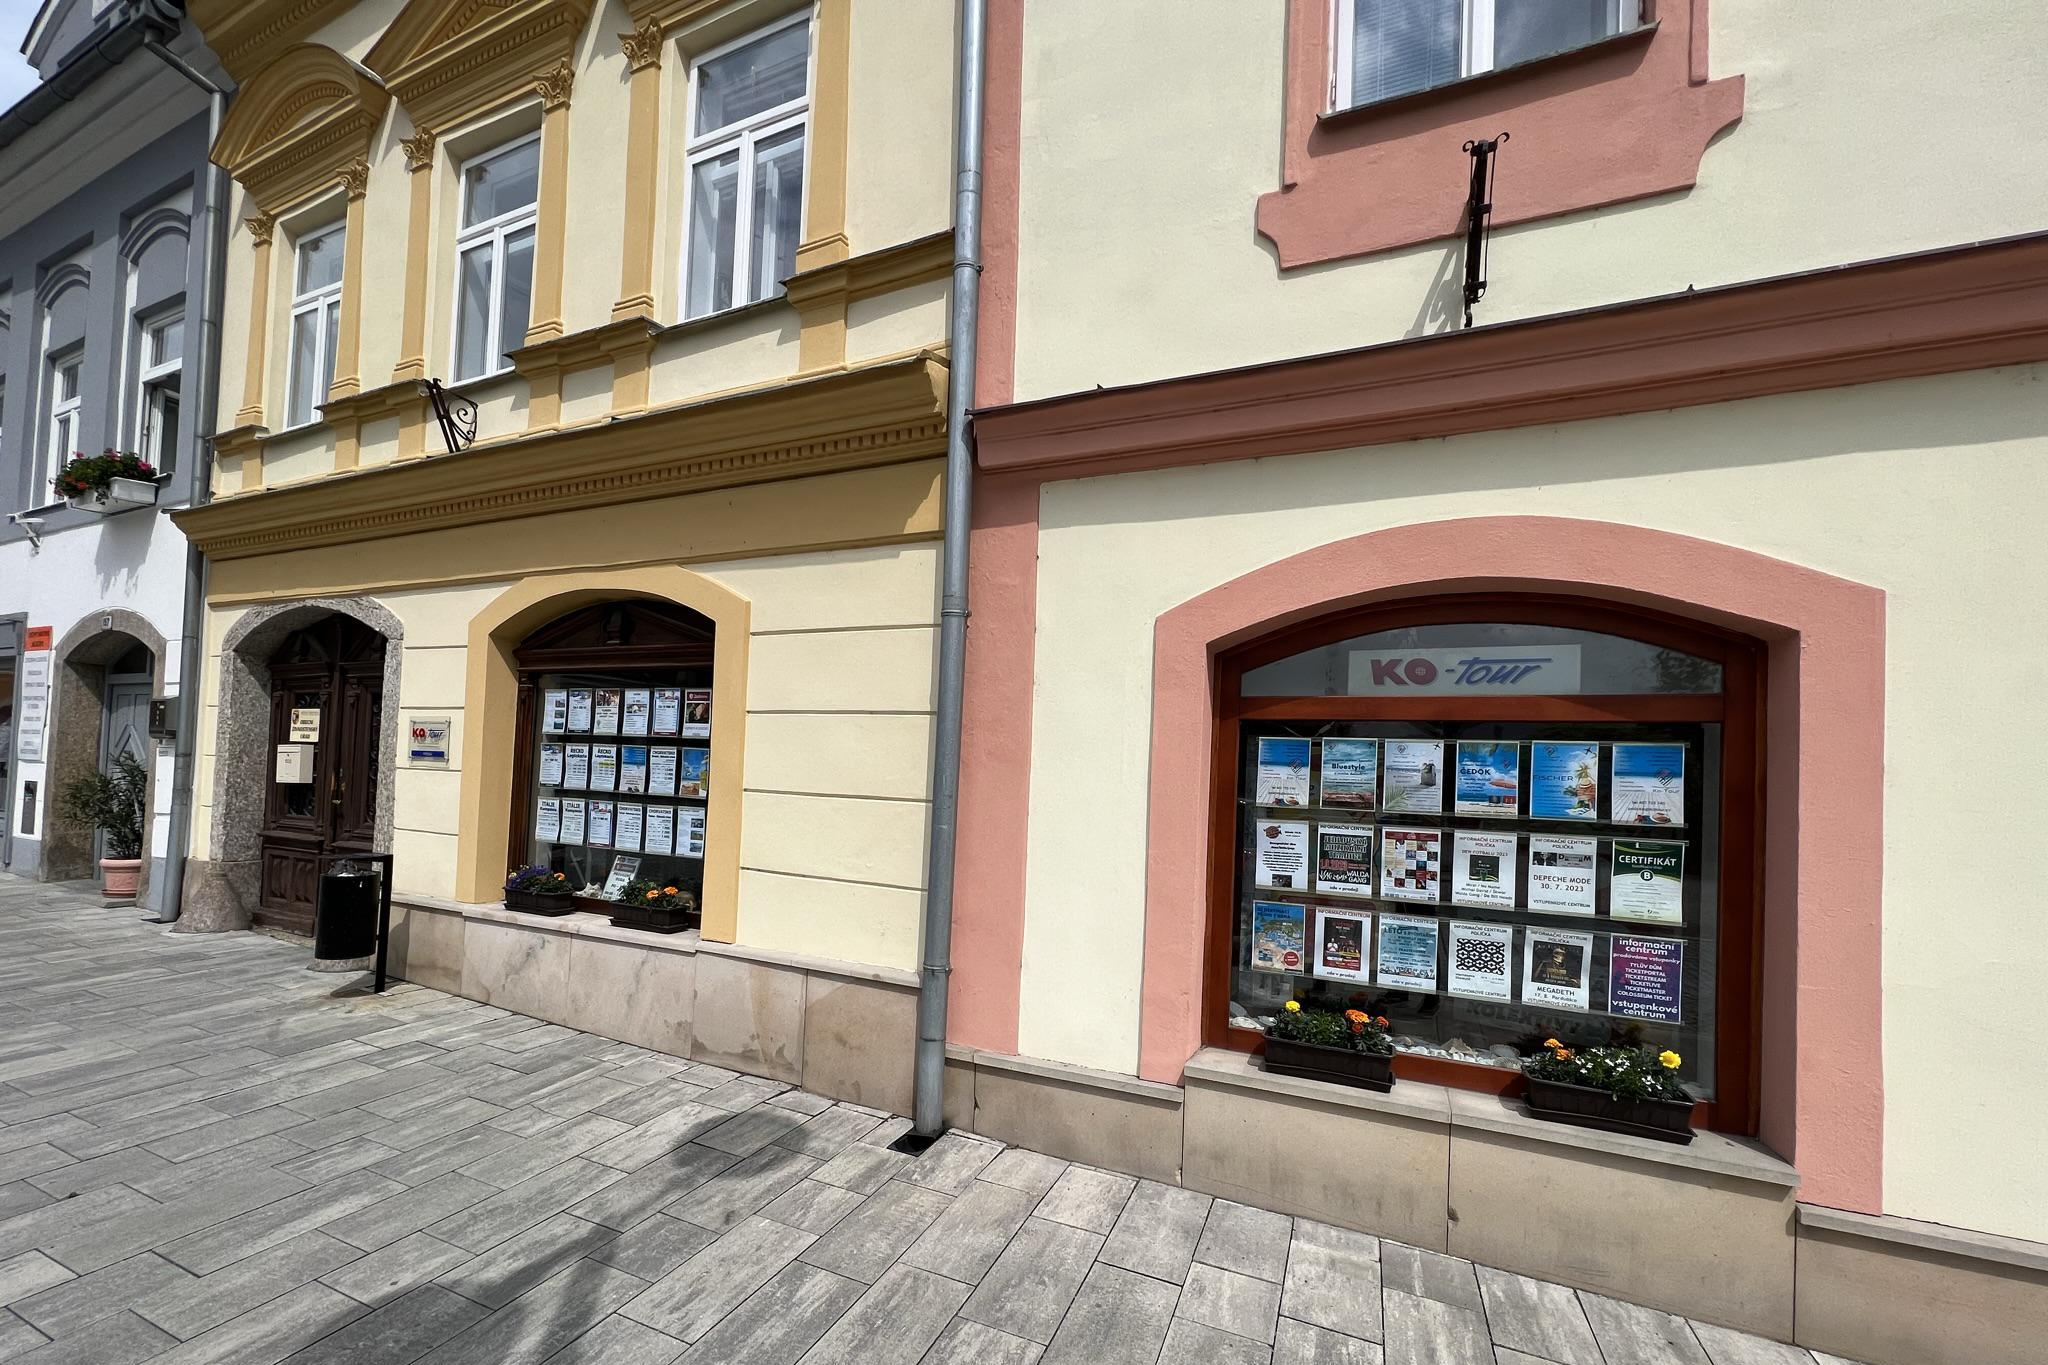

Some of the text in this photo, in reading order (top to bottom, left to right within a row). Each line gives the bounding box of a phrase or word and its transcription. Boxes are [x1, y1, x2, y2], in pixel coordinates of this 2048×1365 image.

[1331, 763, 1366, 771] Bluestyle
[1460, 766, 1491, 775] ČEDOK
[1618, 855, 1677, 866] CERTIFIKÁT
[1533, 874, 1591, 885] DEPECHE MODE
[1643, 871, 1651, 880] B
[1565, 884, 1584, 892] 2023
[1619, 938, 1675, 950] informační
[1625, 946, 1668, 955] centrum
[1625, 968, 1666, 977] TICKETPORTAL
[1625, 974, 1667, 982] TICKETSTREAM
[1630, 980, 1661, 988] TICKETLIVE
[1536, 986, 1575, 996] MEGADETH
[1617, 990, 1653, 998] COLOSSEUM
[1625, 985, 1666, 994] TICKETMASTER
[1612, 1000, 1678, 1013] vstupenkové
[1623, 1008, 1666, 1019] centrum
